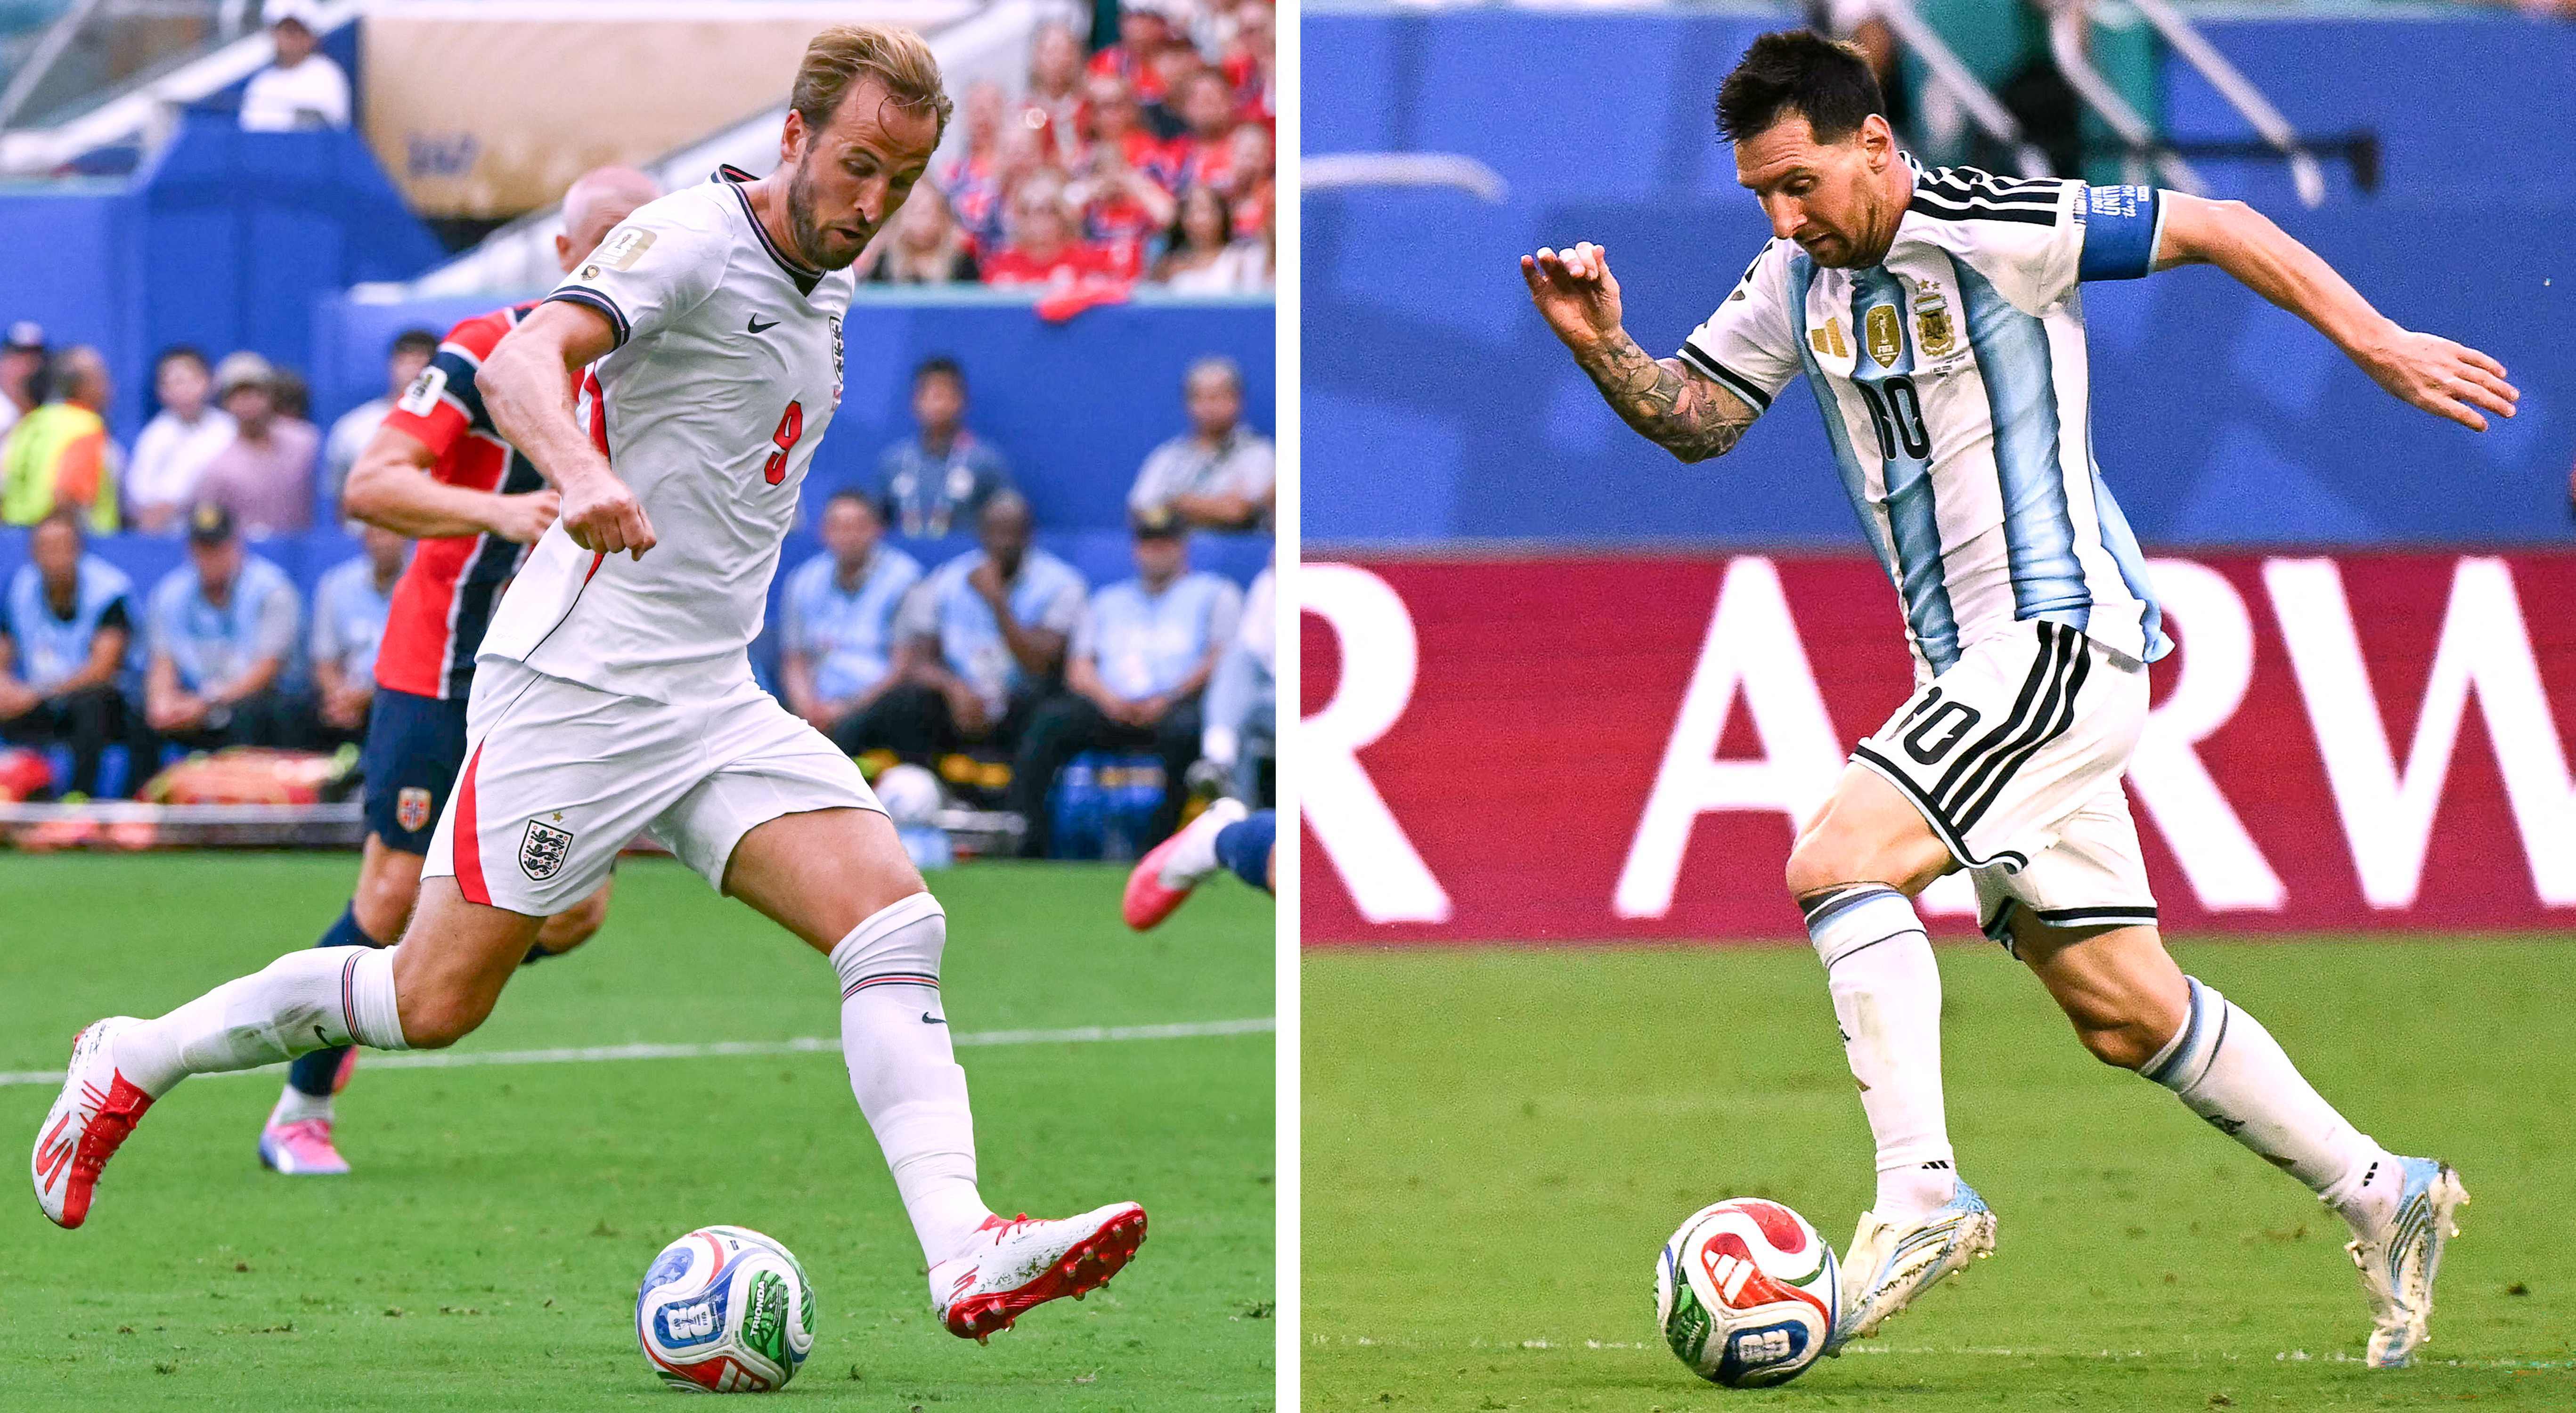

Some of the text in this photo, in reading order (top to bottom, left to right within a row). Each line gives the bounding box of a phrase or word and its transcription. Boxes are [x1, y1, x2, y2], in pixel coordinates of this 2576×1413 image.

[764, 400, 803, 486] 9
[1857, 374, 1931, 461] 10
[1613, 555, 2576, 914] ARW
[1885, 686, 1981, 765] 10
[750, 1281, 766, 1337] TRIONDA
